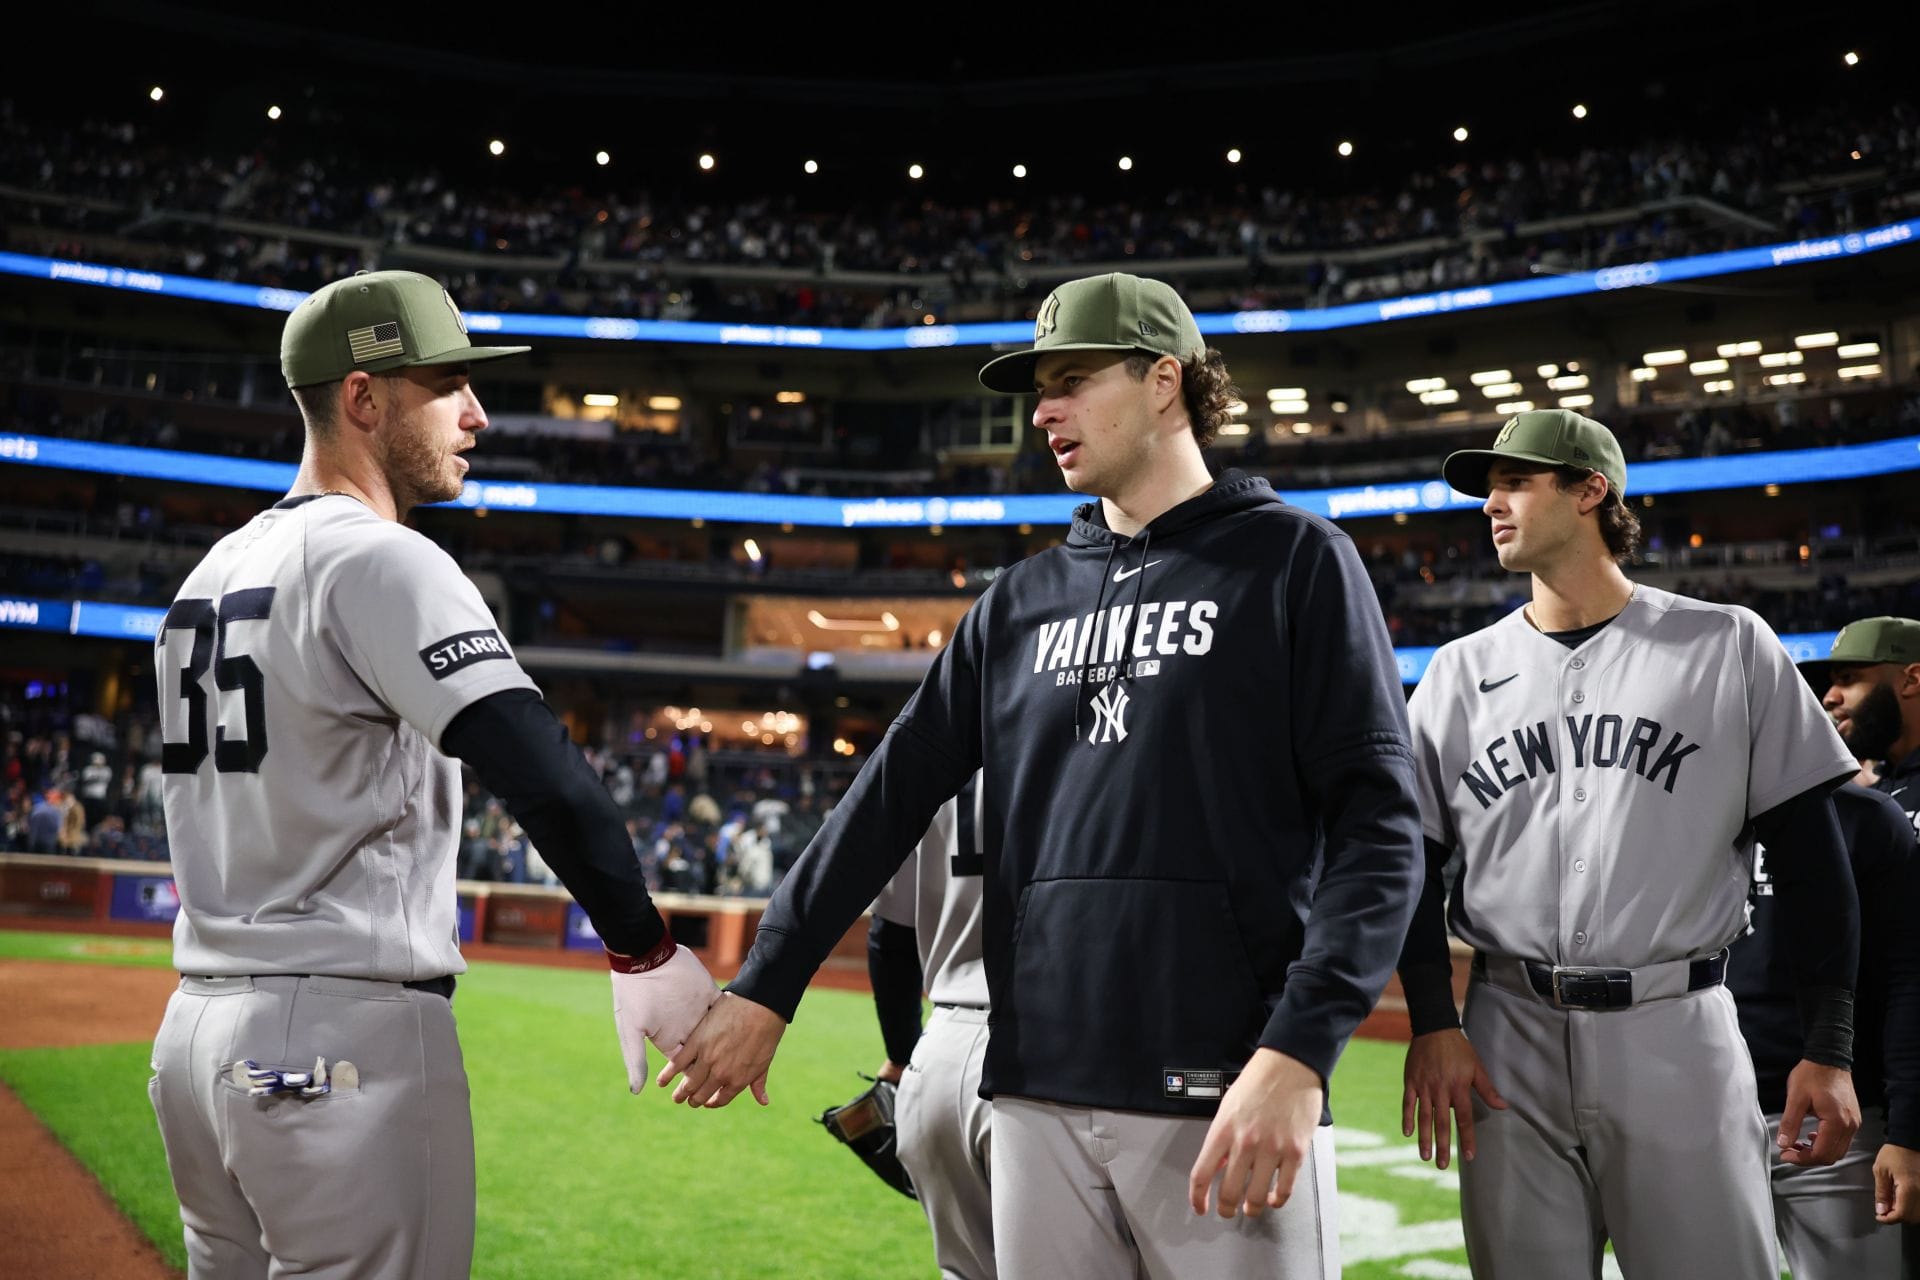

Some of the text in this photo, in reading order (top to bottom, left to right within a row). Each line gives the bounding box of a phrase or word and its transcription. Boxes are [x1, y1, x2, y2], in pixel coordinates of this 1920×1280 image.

[429, 636, 504, 670] STARR
[1034, 600, 1219, 673] YANKEES
[161, 587, 276, 774] 35
[1088, 685, 1130, 745] NY
[1461, 714, 1701, 810] NEW YORK
